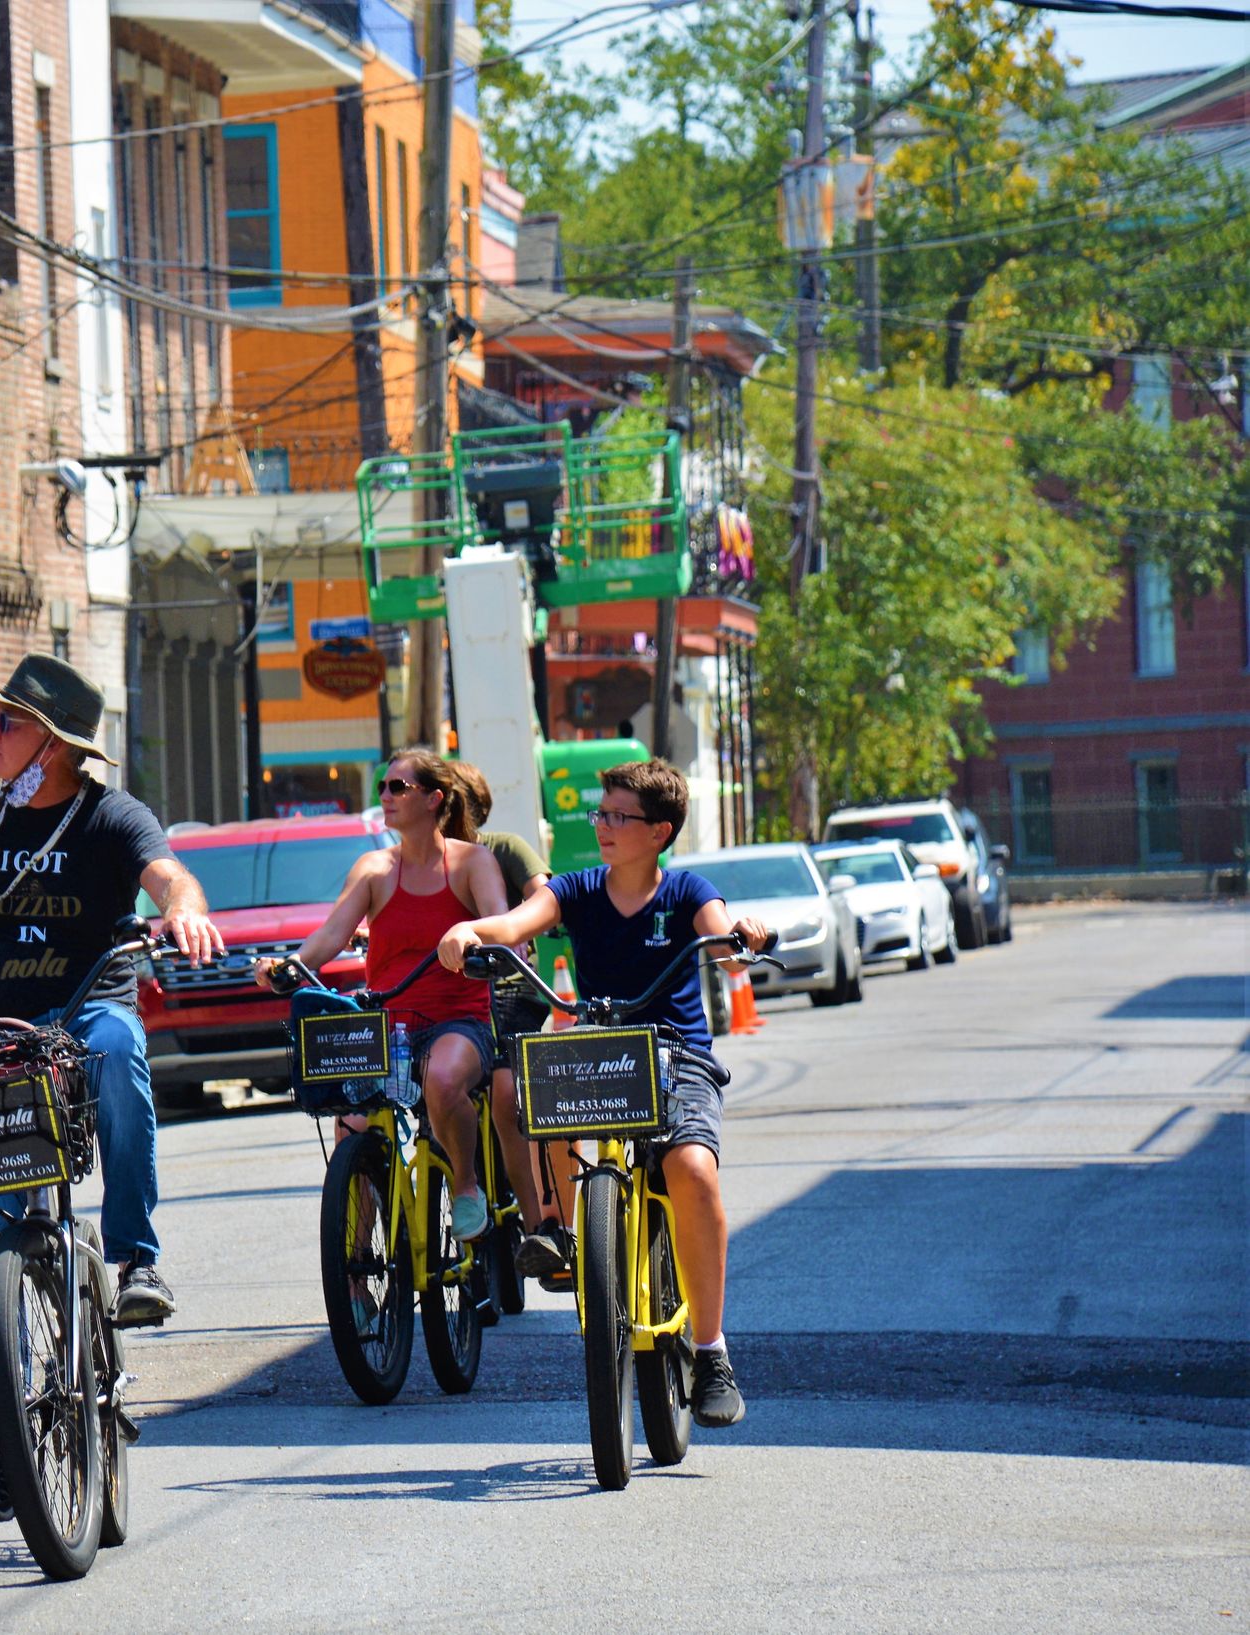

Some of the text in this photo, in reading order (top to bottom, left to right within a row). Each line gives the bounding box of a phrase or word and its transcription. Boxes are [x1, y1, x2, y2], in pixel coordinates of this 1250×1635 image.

[0, 850, 68, 873] I GOT
[17, 926, 46, 942] IN
[0, 948, 69, 980] nola
[347, 1027, 374, 1040] nola
[548, 1053, 636, 1077] BUZZ nola
[556, 1097, 628, 1113] 504.533.9688
[536, 1110, 649, 1125] WWW.BUZZNOLA.COM
